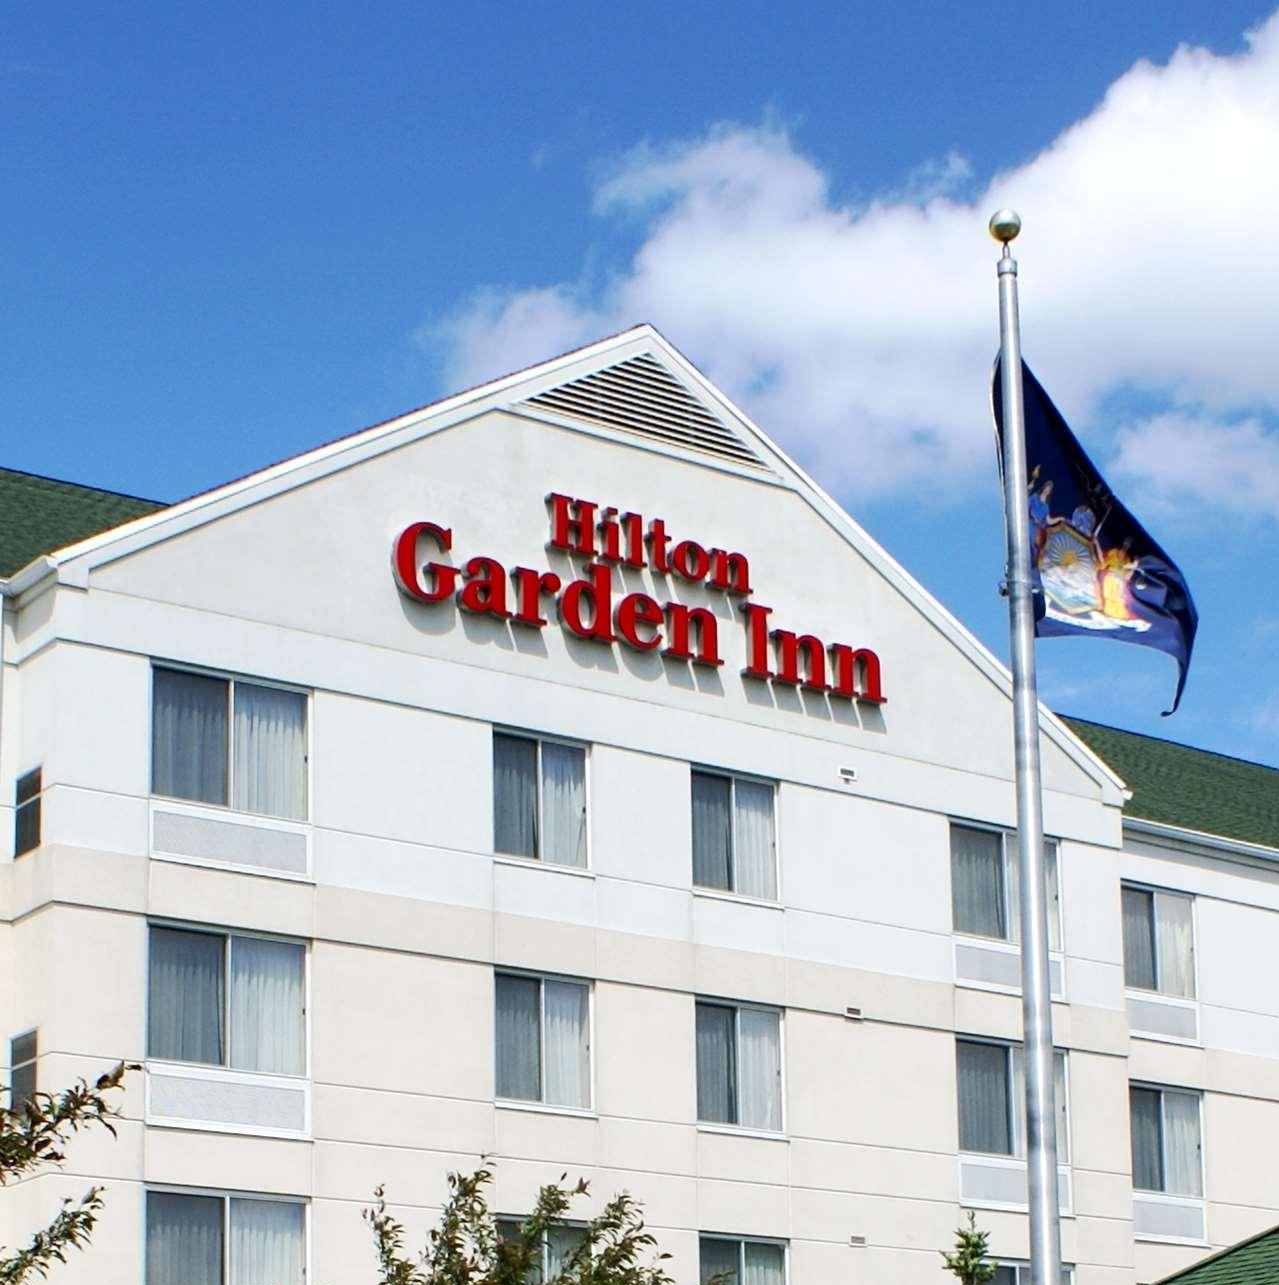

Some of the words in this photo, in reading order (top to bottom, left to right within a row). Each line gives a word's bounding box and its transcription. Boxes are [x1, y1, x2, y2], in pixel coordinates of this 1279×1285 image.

[392, 521, 724, 666] Garden
[741, 602, 888, 703] Inn
[545, 492, 753, 595] Hilton
